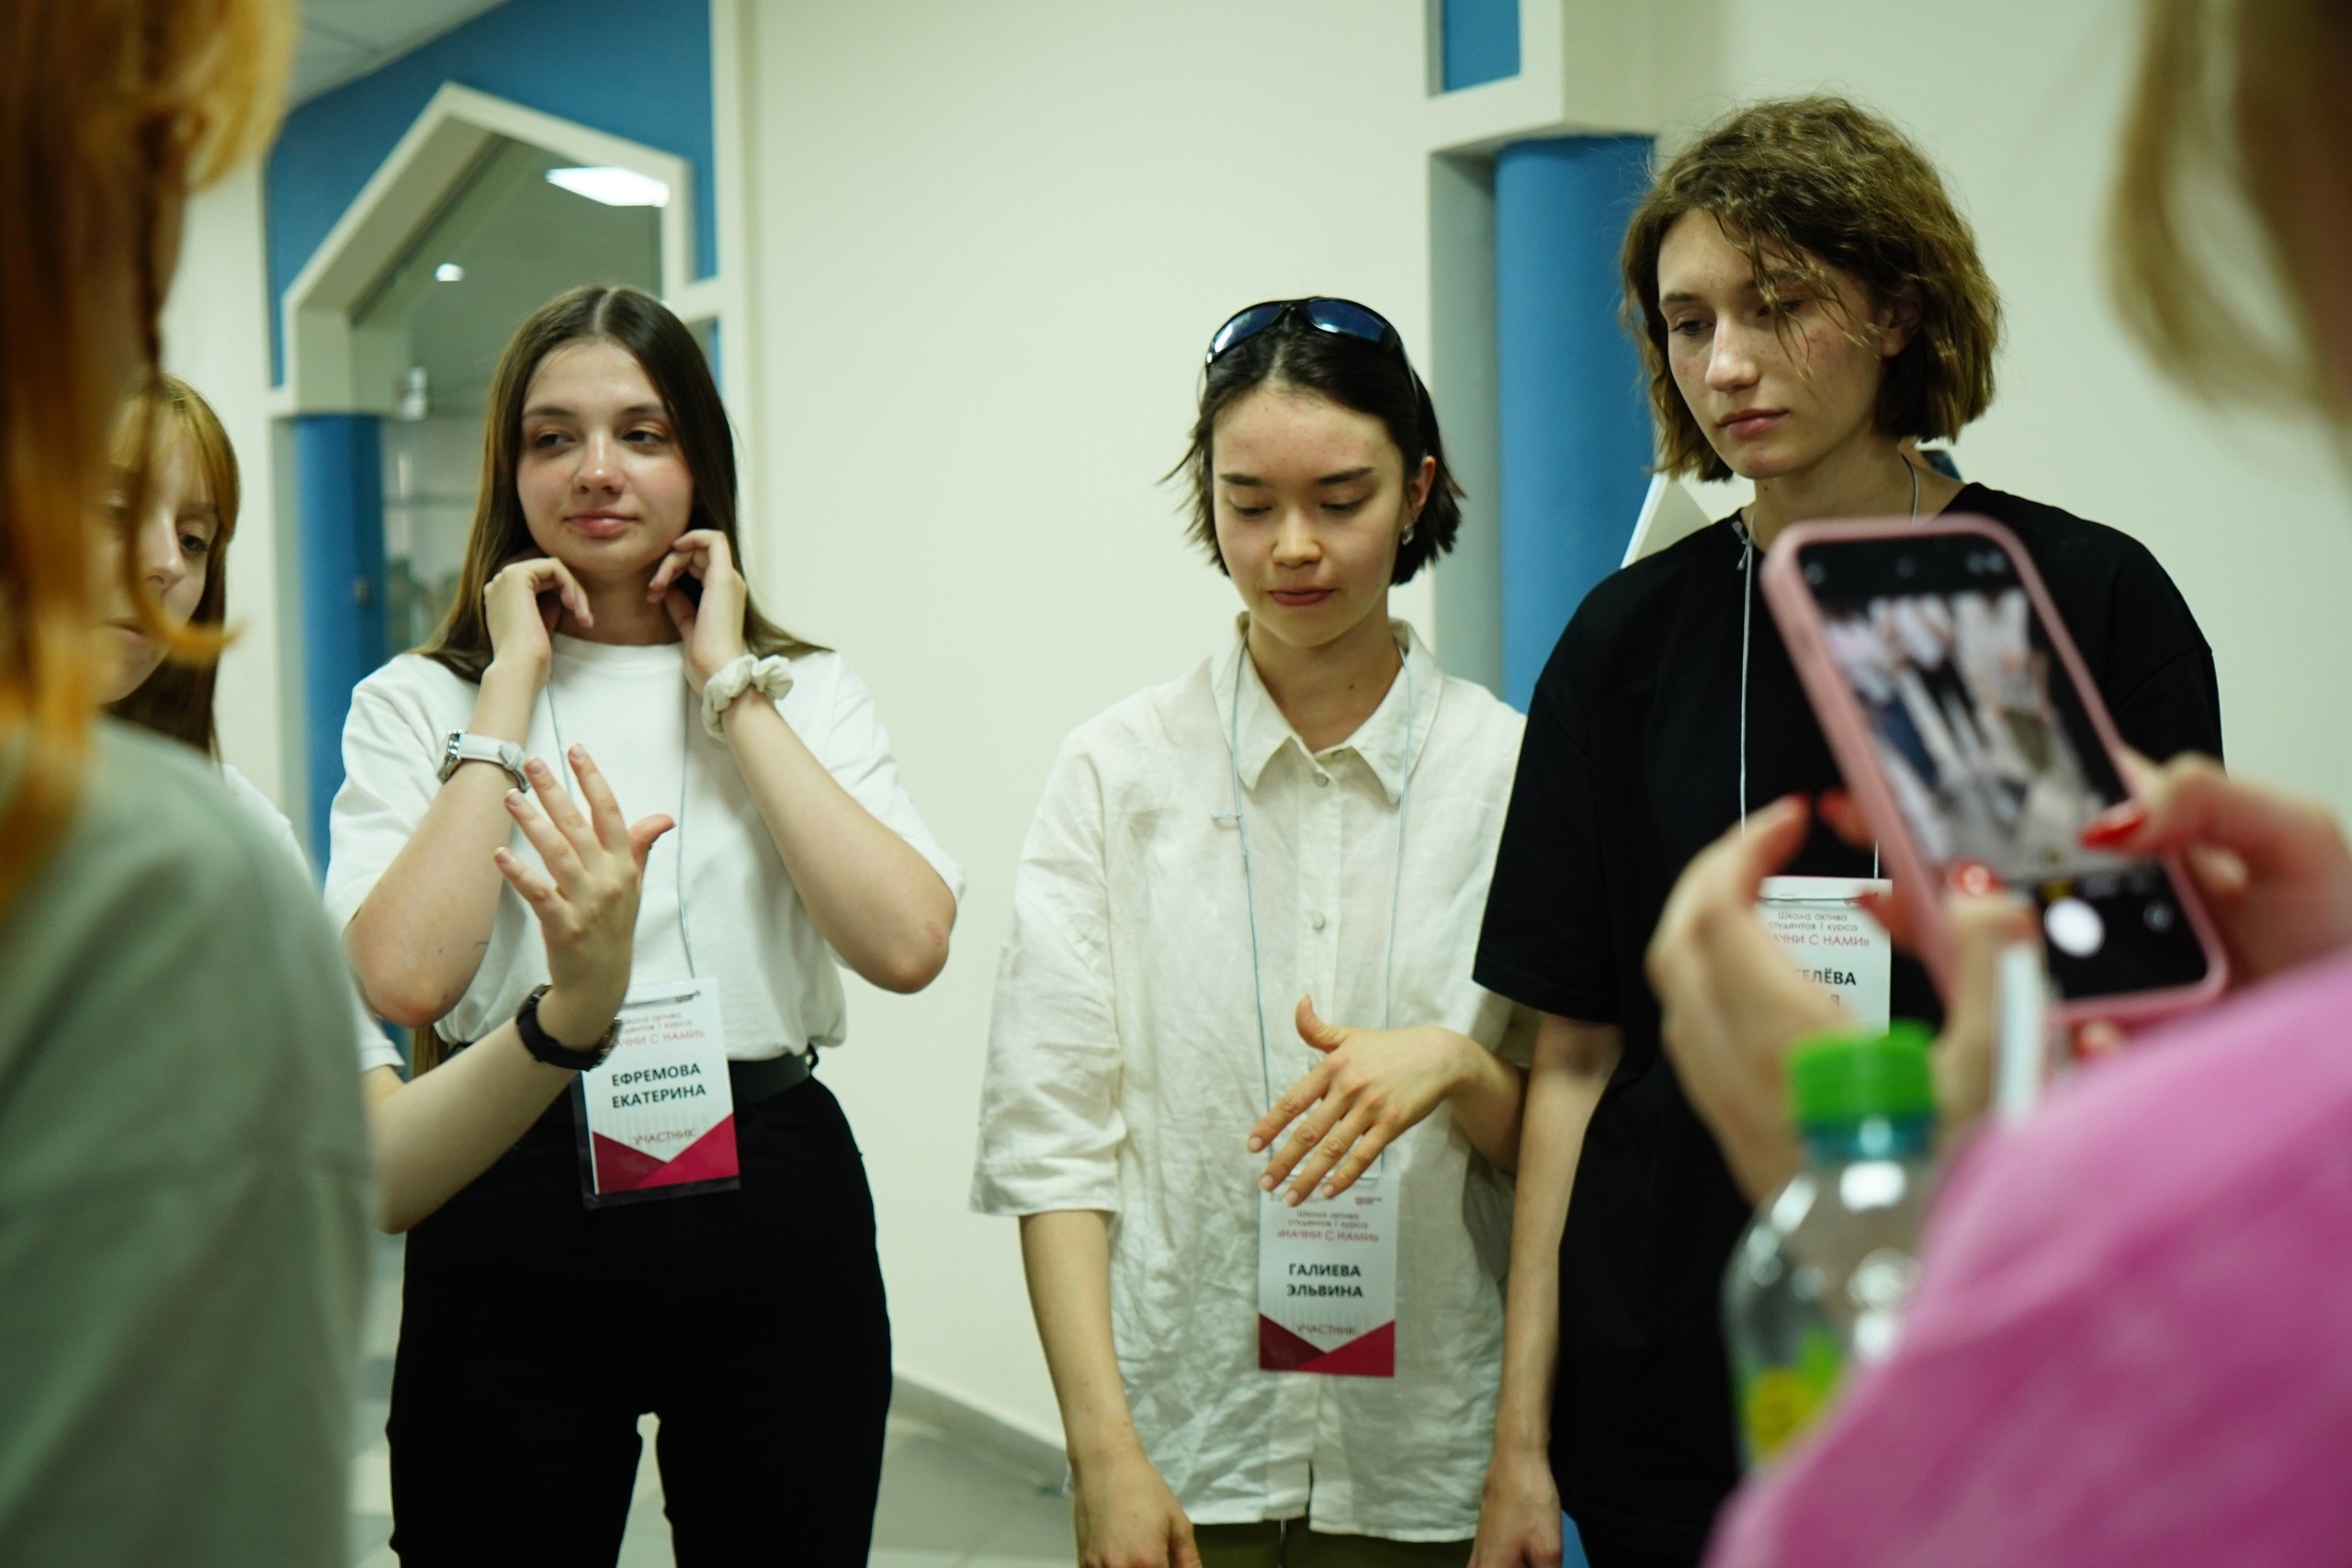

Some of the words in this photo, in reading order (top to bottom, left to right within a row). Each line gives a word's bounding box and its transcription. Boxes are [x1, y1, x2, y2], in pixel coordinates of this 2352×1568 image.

[1778, 910, 1811, 920] Школа
[1814, 913, 1848, 921] актива
[1826, 924, 1858, 933] курса
[1808, 934, 1819, 945] С
[1823, 936, 1870, 947] НАМИ»
[650, 1034, 659, 1044] С
[662, 1030, 705, 1043] НАМИ»
[611, 1063, 701, 1087] ЕФРЕМОВА
[612, 1084, 707, 1109] ЕКАТЕРИНА
[633, 1128, 695, 1145] УЧАСТНИК
[1324, 1230, 1334, 1241] С
[1337, 1232, 1378, 1243] НАМИ»
[1288, 1263, 1362, 1278] ГАЛИЕВА
[1286, 1283, 1363, 1298] ЭЛЬВИНА
[1297, 1324, 1356, 1336] УЧАСТНИК
